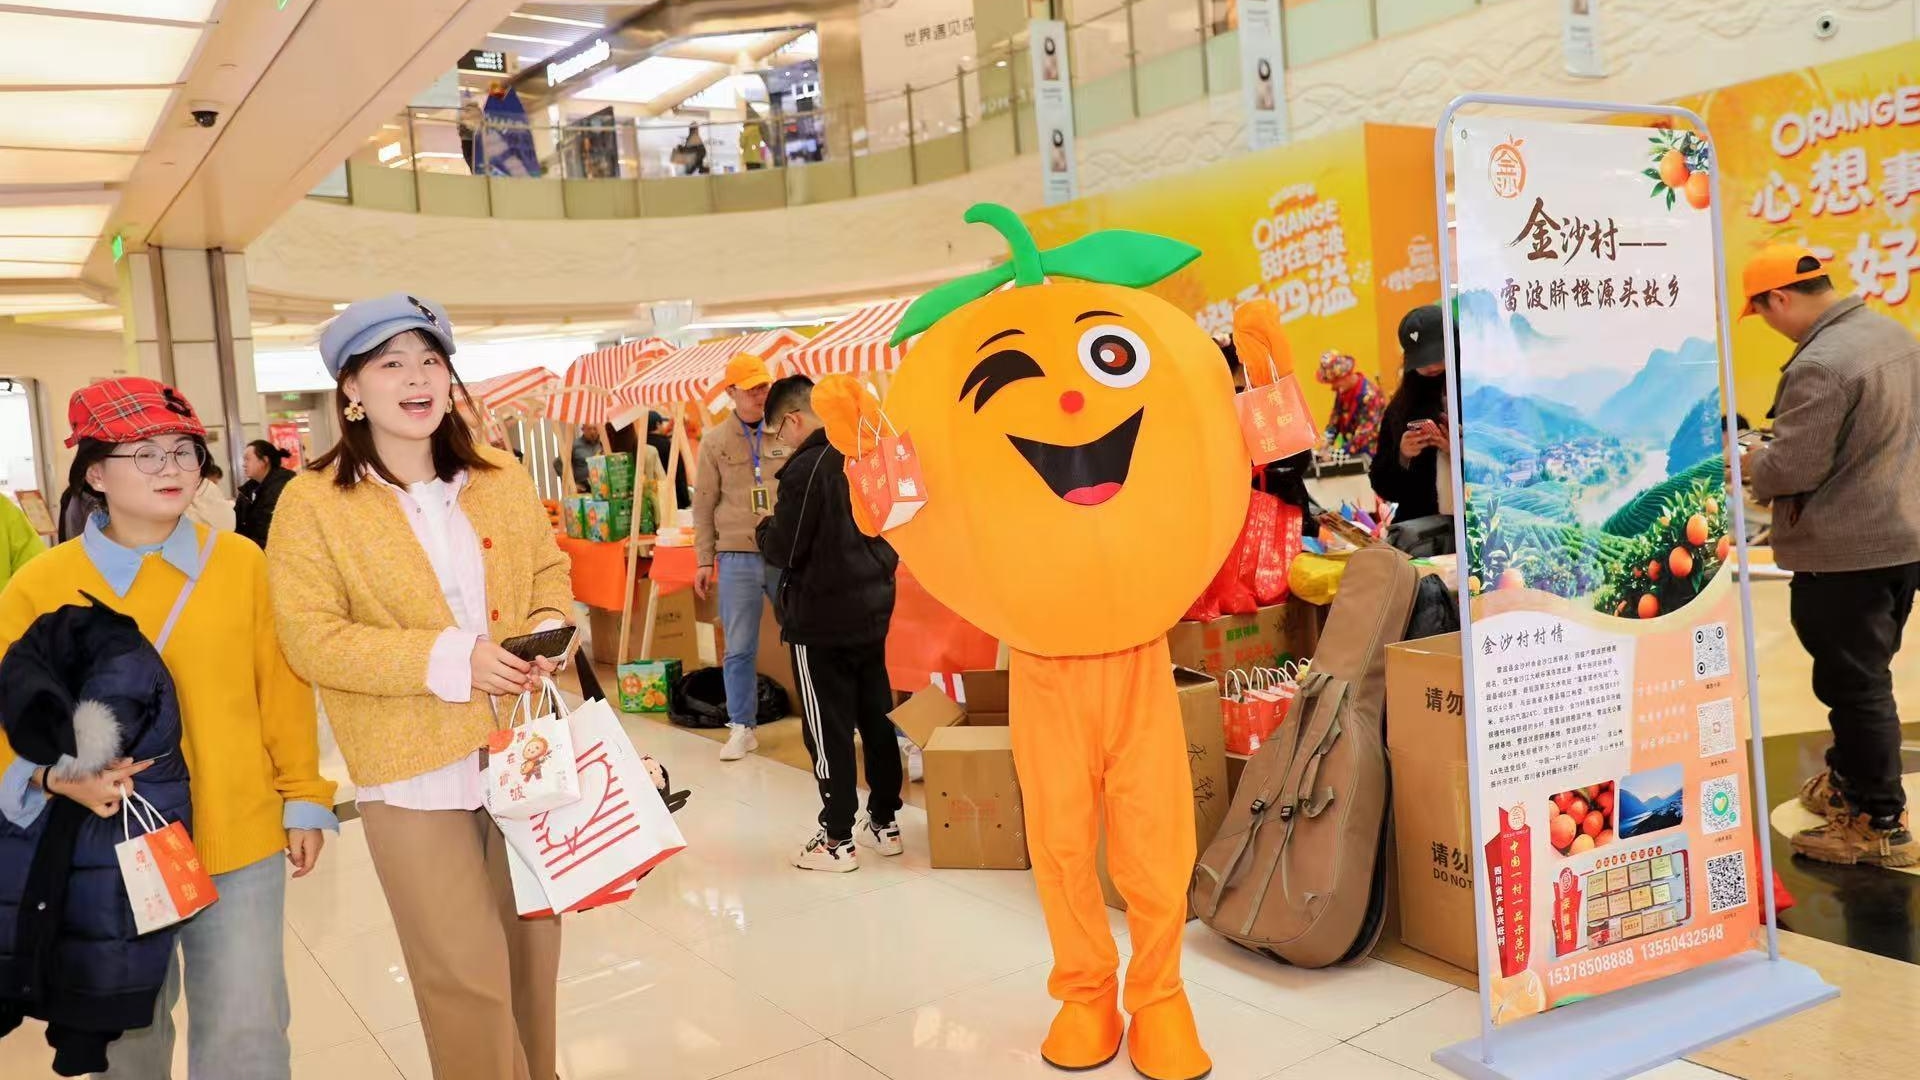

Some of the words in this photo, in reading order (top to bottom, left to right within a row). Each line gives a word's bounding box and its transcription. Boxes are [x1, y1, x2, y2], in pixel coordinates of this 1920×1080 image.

[1772, 85, 1920, 157] ORANGE
[1252, 198, 1340, 250] ORANGE
[1500, 274, 1681, 312] 雷波脐橙源头故乡
[1481, 622, 1567, 656] 金沙村村情
[1425, 687, 1464, 717] 请勿
[1431, 841, 1469, 875] 请勿
[1432, 867, 1448, 882] DO
[1450, 873, 1472, 889] NOT
[1493, 866, 1506, 947] 四川省产业兴旺村
[1509, 839, 1526, 963] 中国一村一品示范村
[1547, 946, 1634, 986] 15378508888
[1640, 923, 1724, 961] 13550432548
